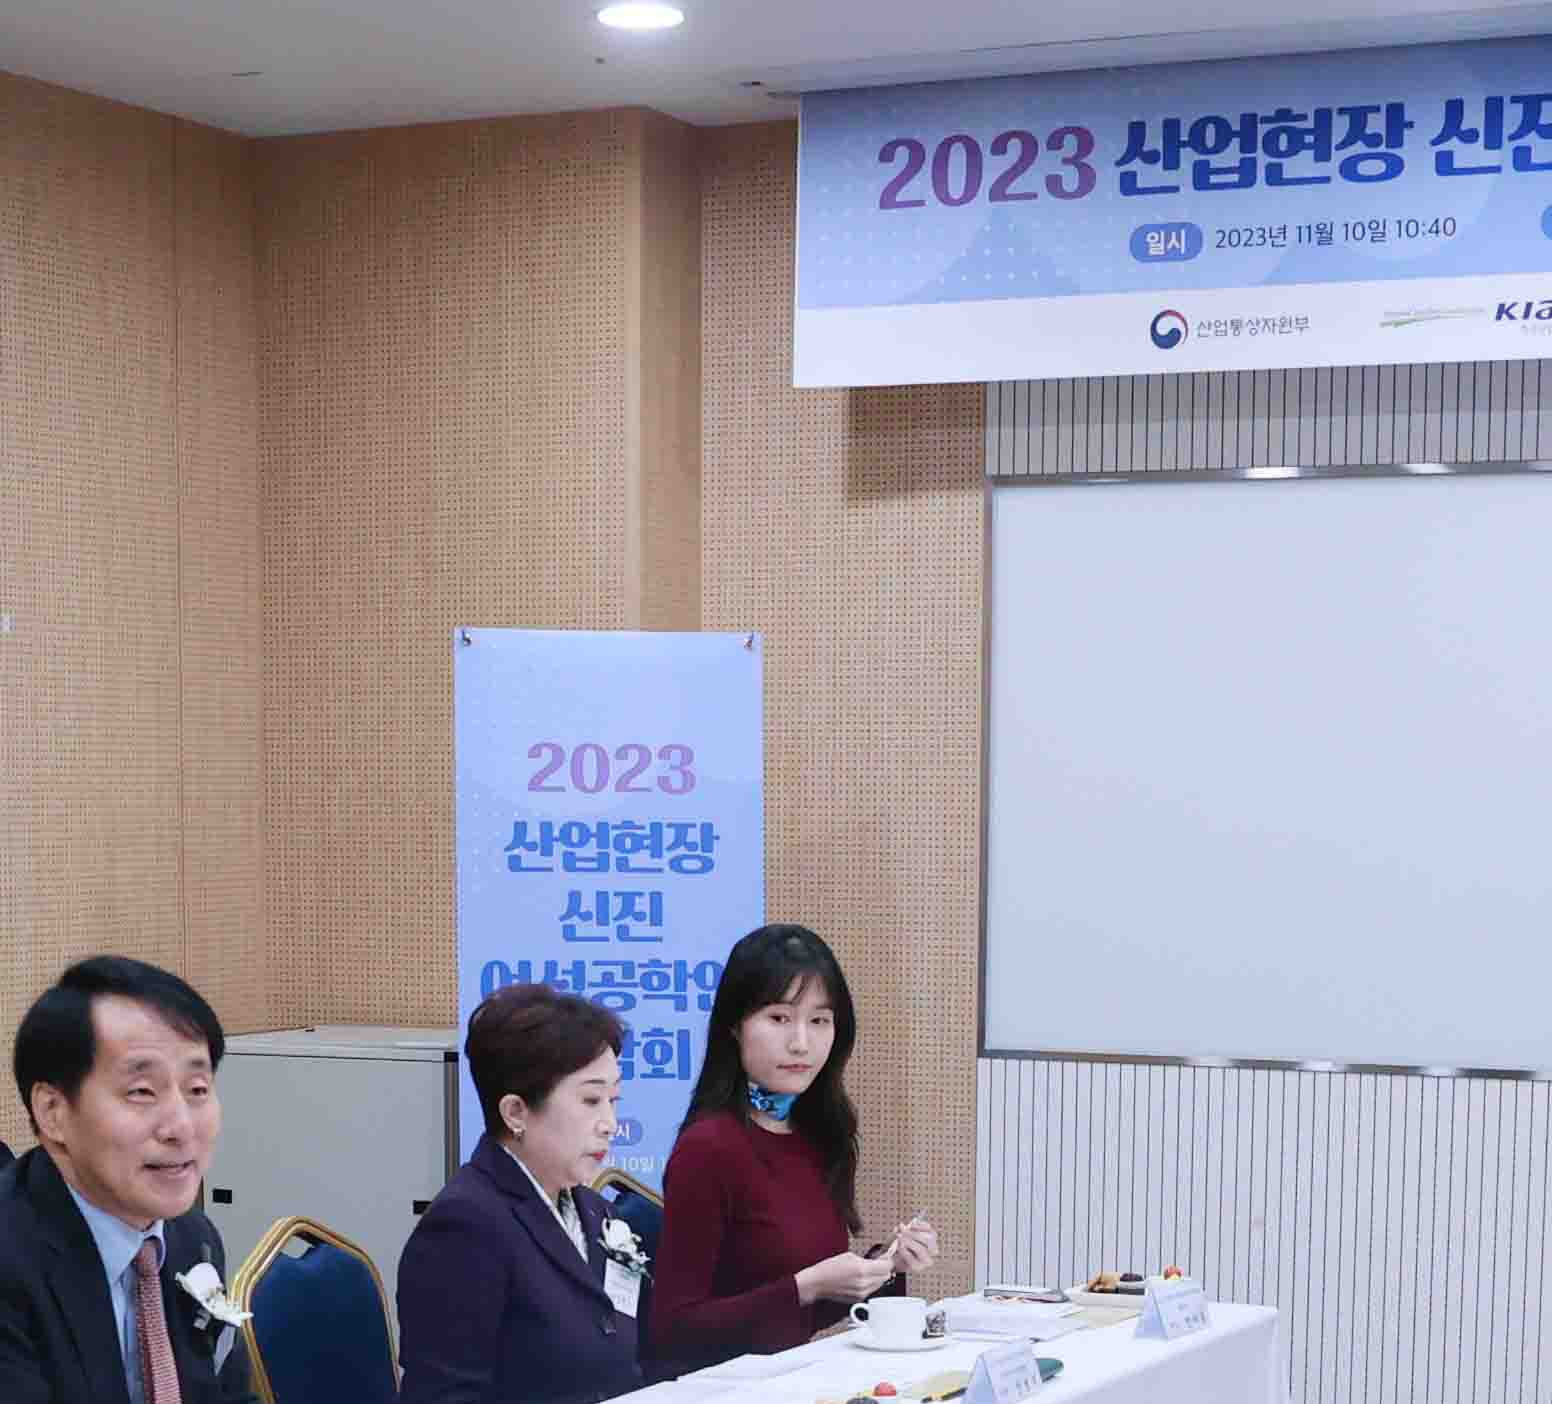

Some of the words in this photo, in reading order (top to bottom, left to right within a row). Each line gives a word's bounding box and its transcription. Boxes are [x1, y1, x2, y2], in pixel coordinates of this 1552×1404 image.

[876, 125, 1098, 211] 2023
[1114, 101, 1415, 198] 산업현장
[1145, 229, 1187, 257] 일시
[1214, 222, 1288, 250] 2023년
[1296, 221, 1335, 248] 11월
[1342, 217, 1388, 244] 10일
[1395, 215, 1458, 241] 10:40
[1195, 315, 1311, 338] 산업통상자원부
[526, 741, 698, 796] 2023
[503, 819, 721, 876] 산업현장
[558, 888, 665, 943] 신진
